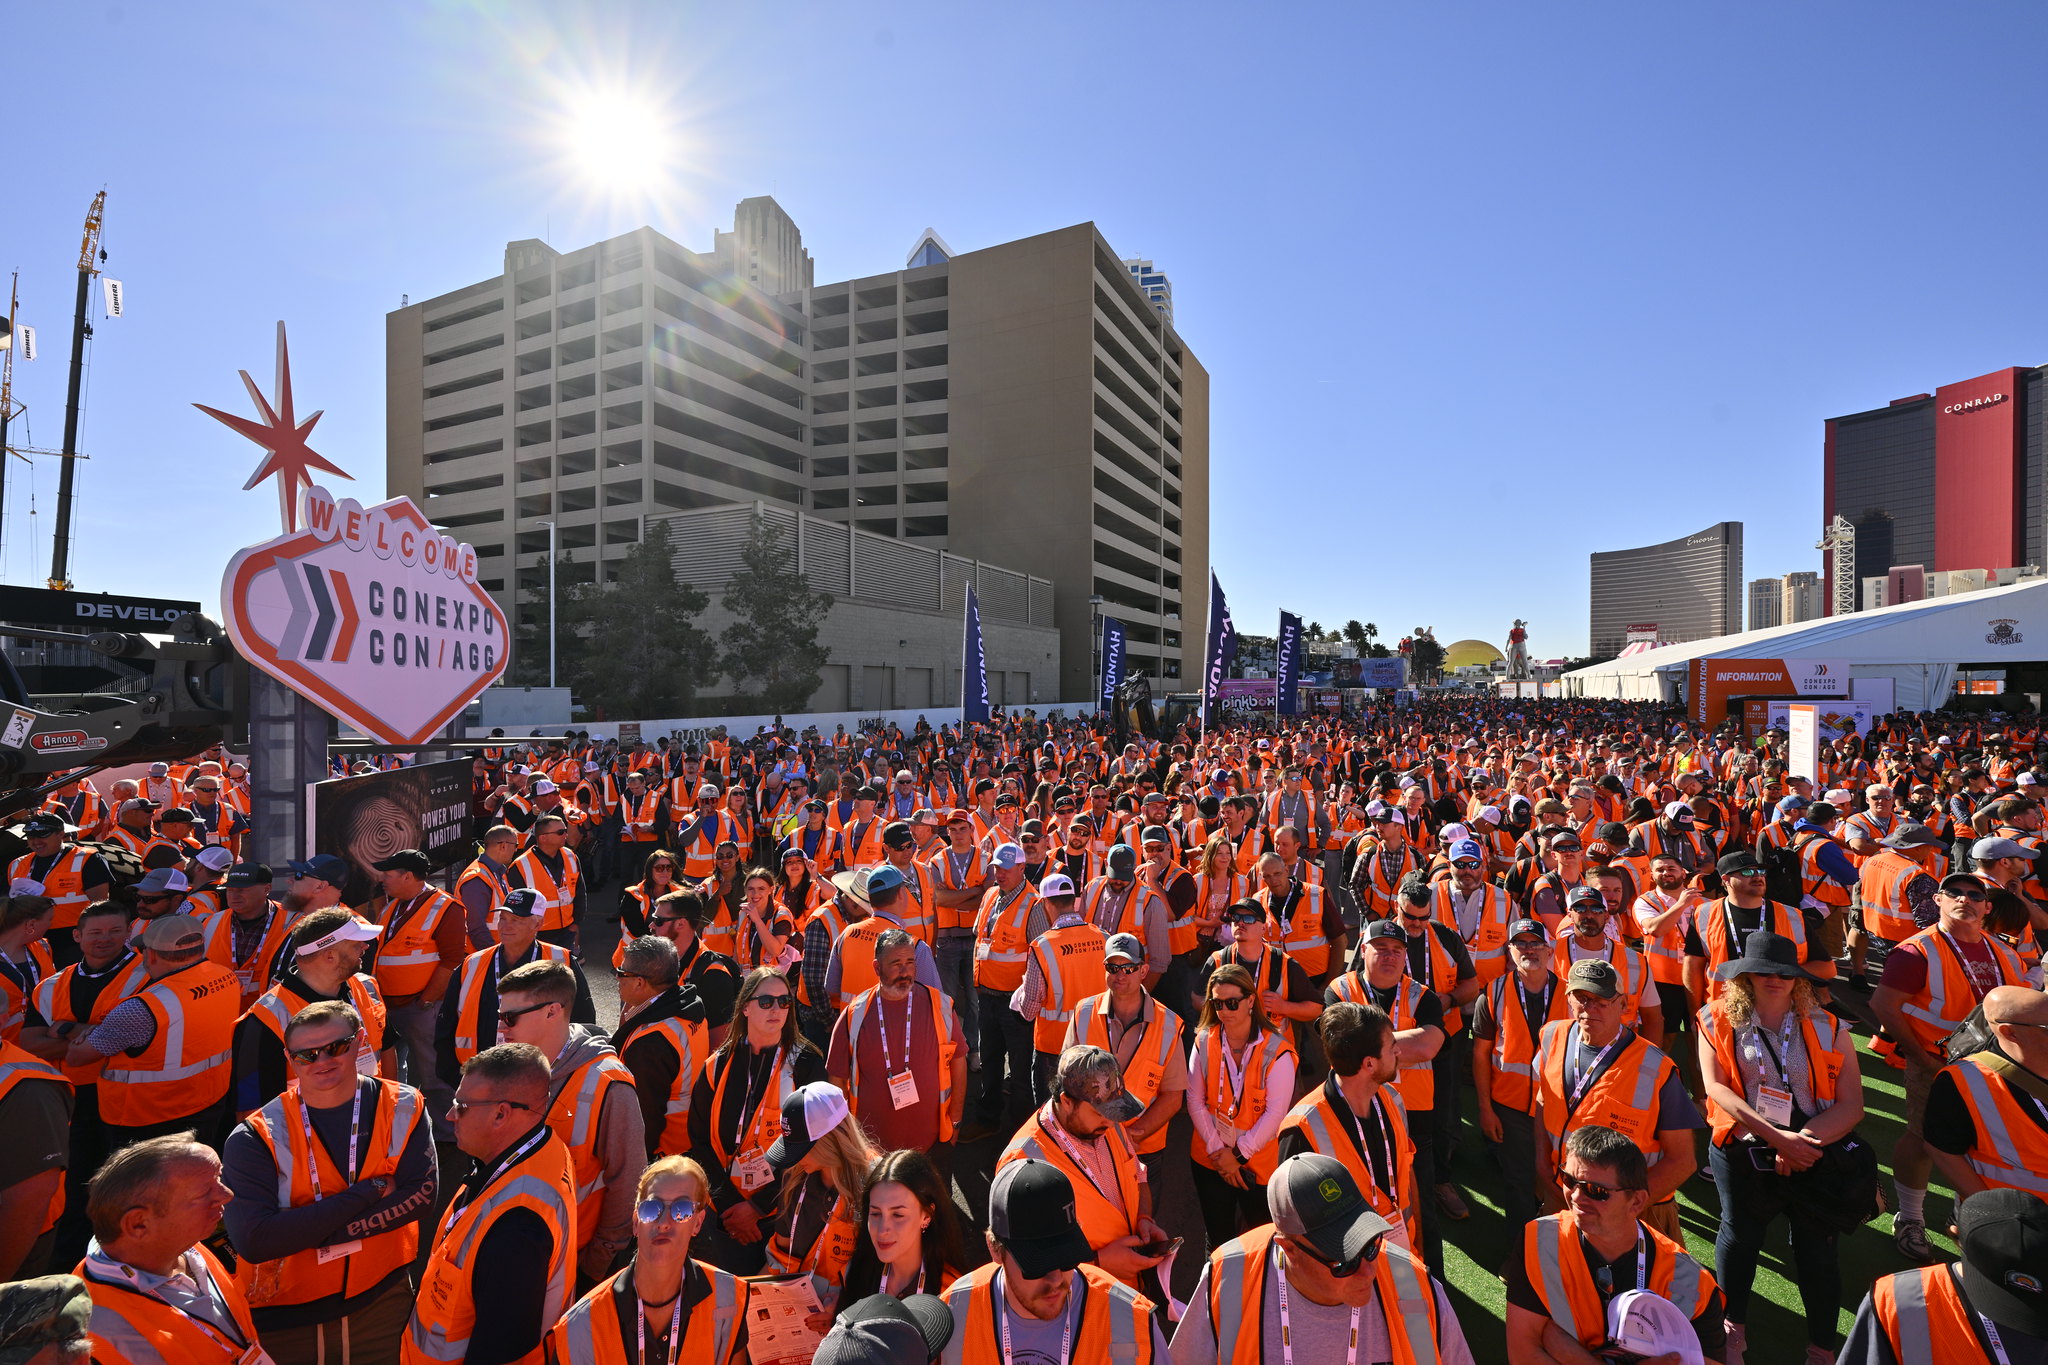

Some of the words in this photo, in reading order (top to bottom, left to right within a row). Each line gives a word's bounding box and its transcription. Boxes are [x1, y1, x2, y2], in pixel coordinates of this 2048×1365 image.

[1944, 393, 2002, 414] CONRAD
[310, 496, 475, 577] WELCOME
[1687, 535, 1720, 547] Encore
[369, 580, 494, 635] CONEXPO
[369, 628, 494, 672] CON/AGG
[1104, 630, 1120, 700] HYUNDAI
[1716, 672, 1782, 682] INFORMATION
[1222, 694, 1276, 711] pinkbox
[43, 735, 78, 746] ARNOLD
[430, 784, 459, 795] VOLVO
[422, 806, 447, 831] POWER
[450, 802, 466, 822] YOUR
[428, 822, 462, 850] AMBITION
[1074, 940, 1102, 948] CONEXPO
